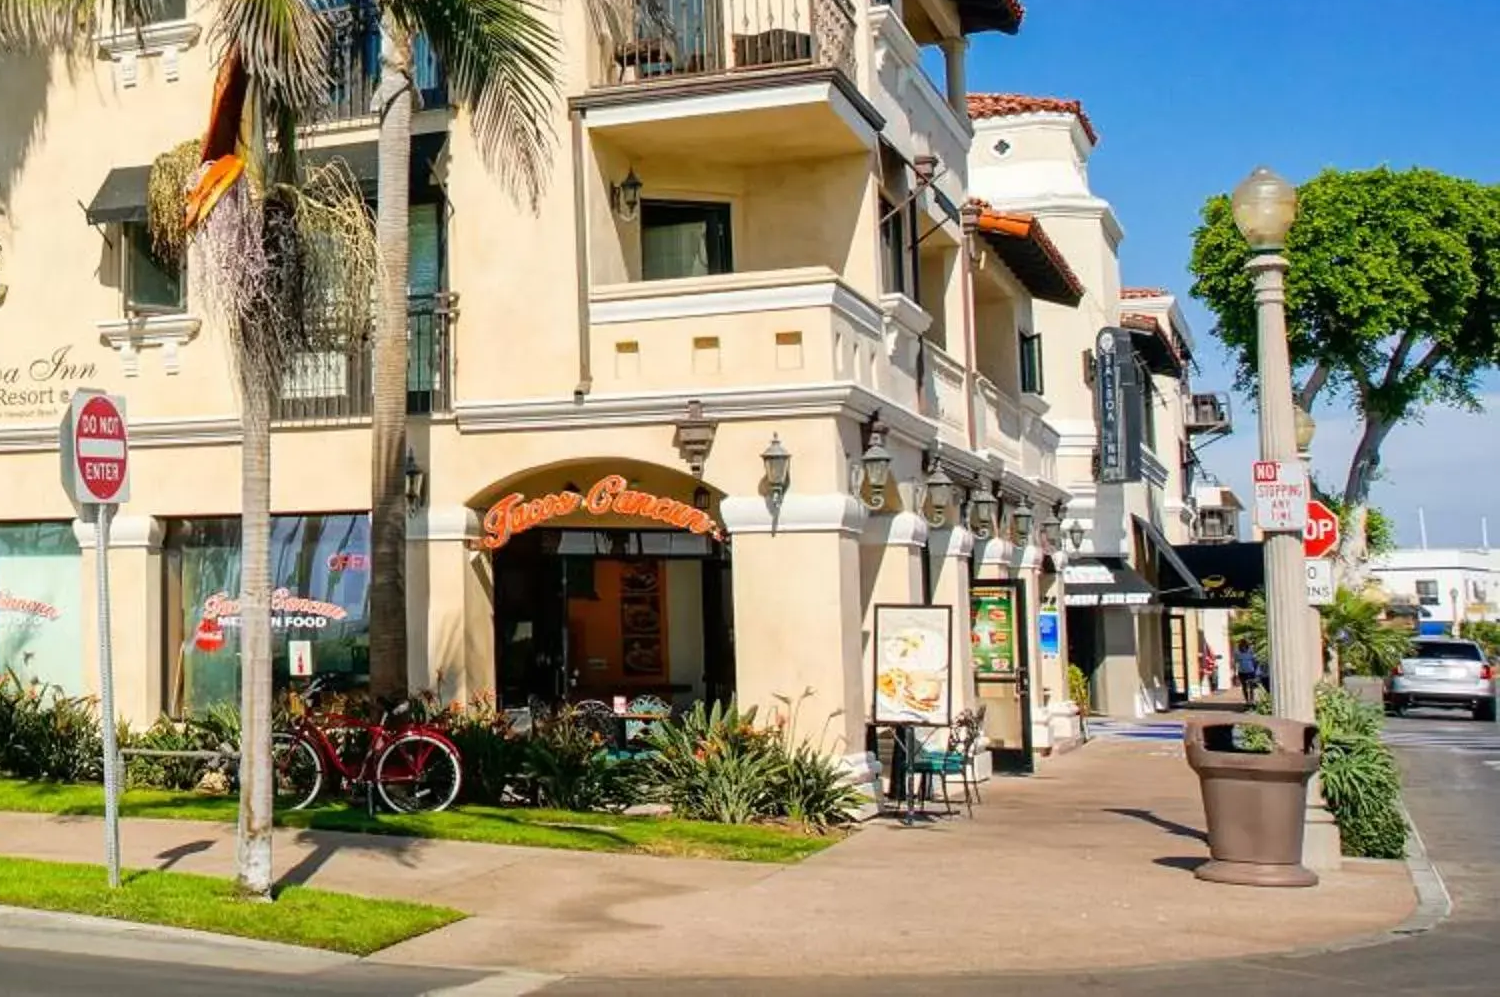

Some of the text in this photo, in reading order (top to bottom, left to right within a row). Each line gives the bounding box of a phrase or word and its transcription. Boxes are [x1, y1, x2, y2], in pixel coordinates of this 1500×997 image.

[30, 345, 98, 381] Inn
[81, 415, 119, 435] DO NOT
[85, 462, 118, 481] ENTER
[1256, 464, 1275, 480] NO
[1258, 485, 1303, 498] STOPPING
[1271, 499, 1291, 510] ANY
[1304, 519, 1333, 540] OP
[285, 616, 327, 628] FOOD
